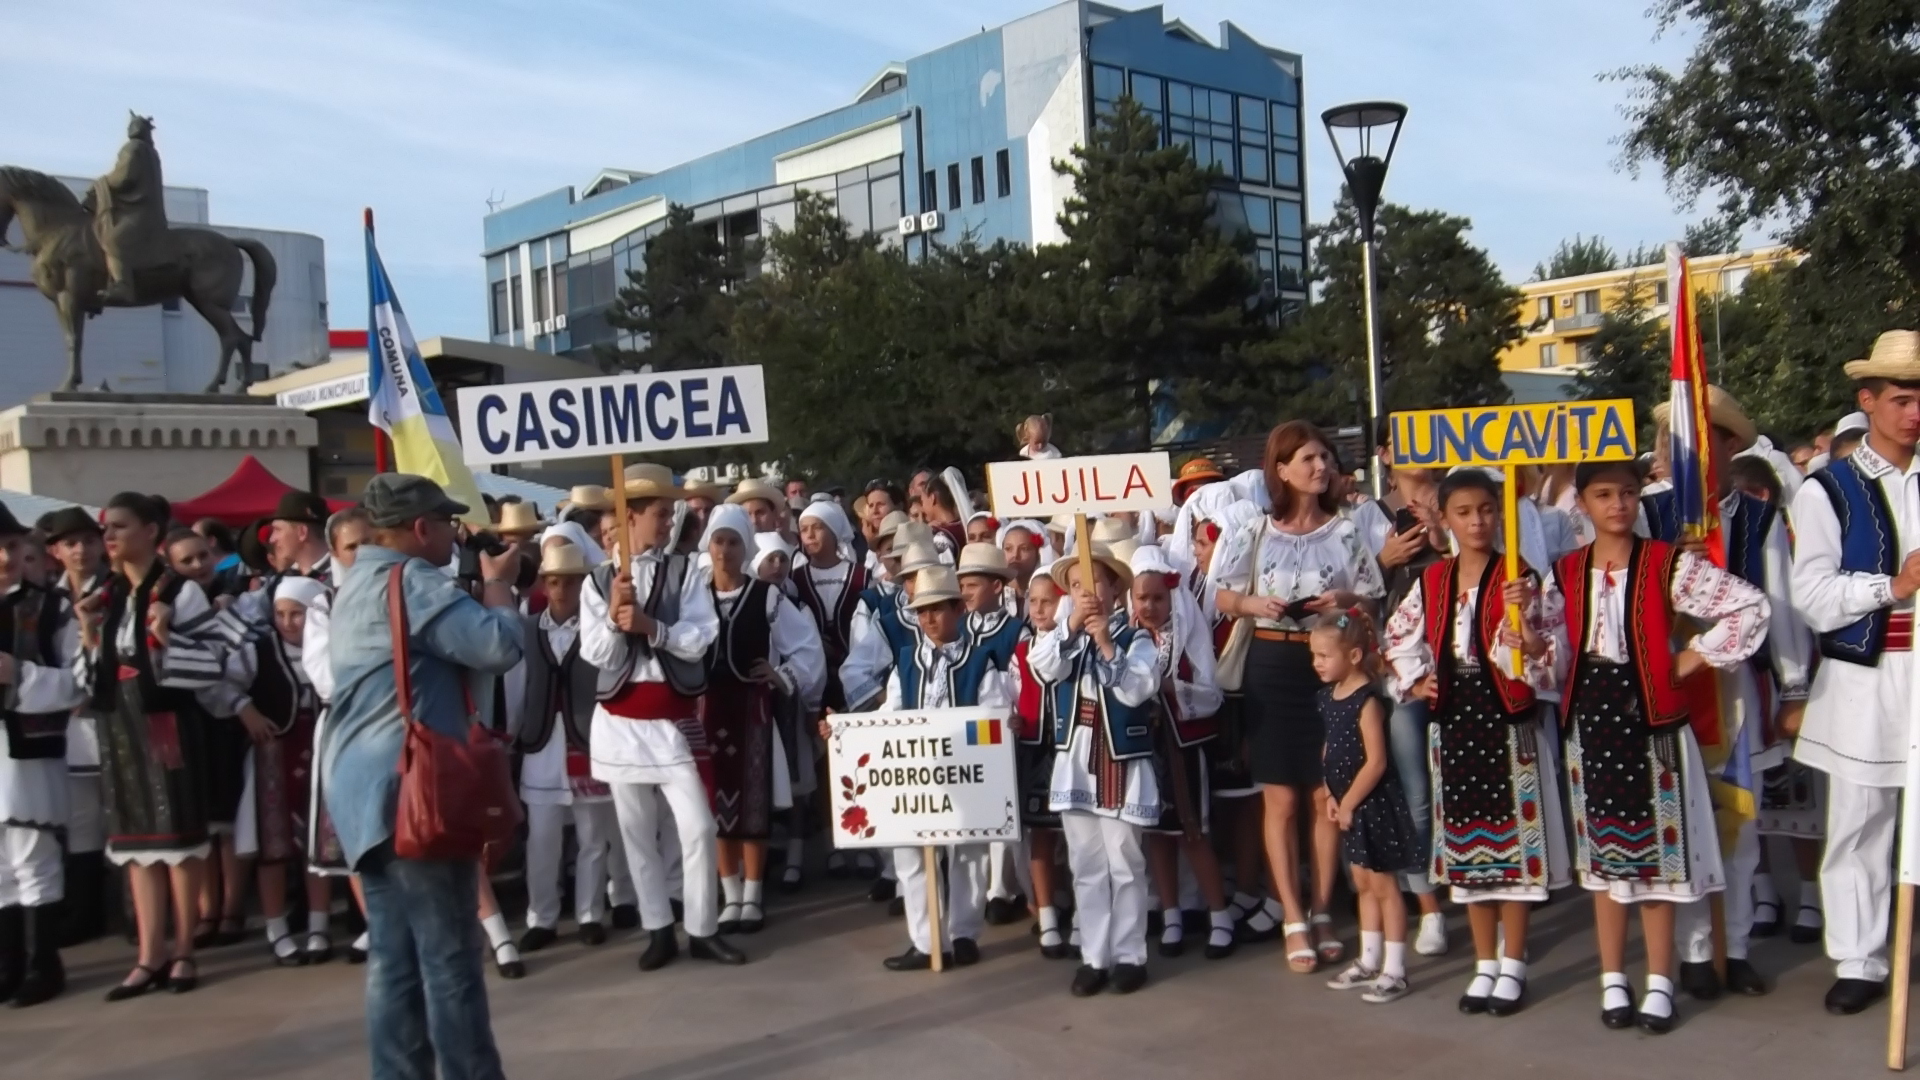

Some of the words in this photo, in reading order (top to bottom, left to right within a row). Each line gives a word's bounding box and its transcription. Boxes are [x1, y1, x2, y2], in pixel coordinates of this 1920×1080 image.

[379, 326, 409, 398] COMUNA
[476, 375, 752, 455] CASIMCEA
[1012, 463, 1154, 506] JIJILA
[868, 763, 985, 787] DOBROGENE
